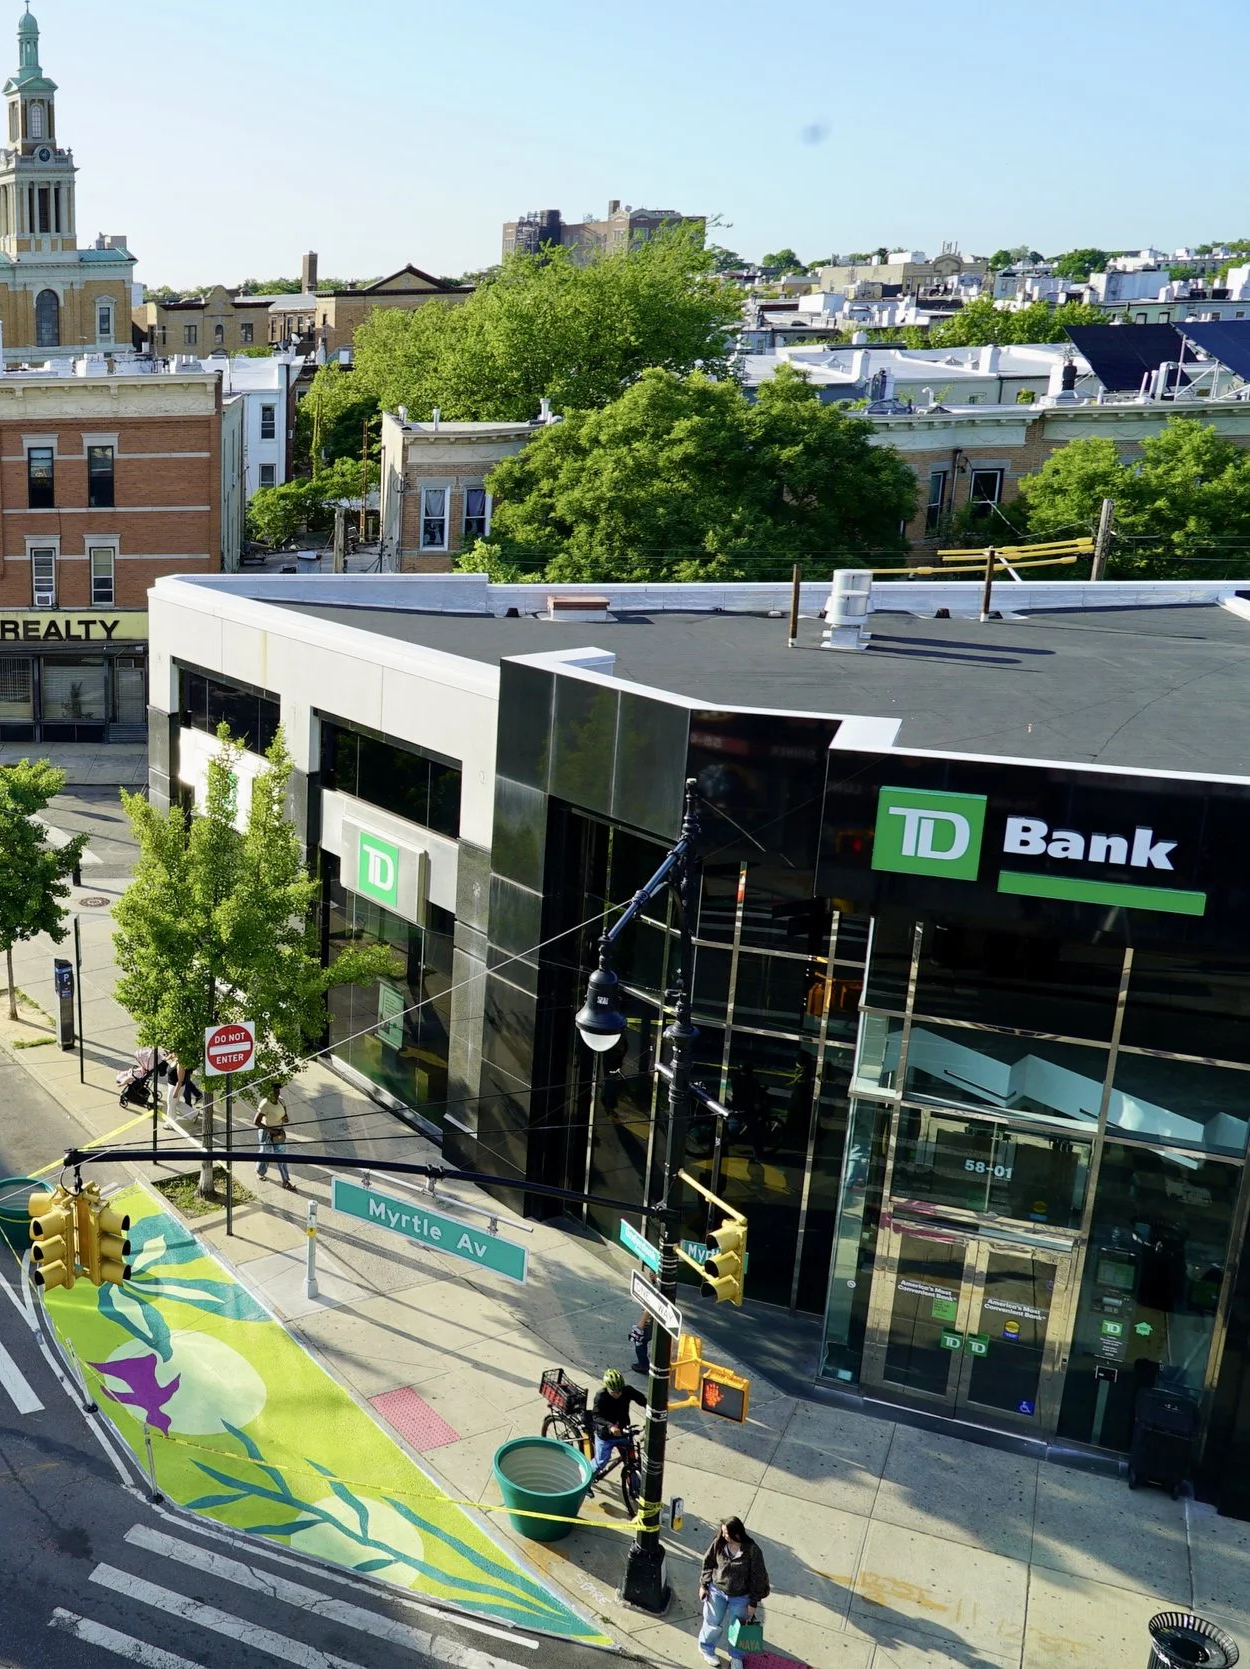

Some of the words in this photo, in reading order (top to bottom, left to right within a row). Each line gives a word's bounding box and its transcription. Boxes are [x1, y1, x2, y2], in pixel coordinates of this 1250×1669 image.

[0, 620, 120, 640] REALTY
[888, 806, 970, 861] TD
[1003, 814, 1178, 871] Bank
[362, 843, 395, 892] TD
[214, 1035, 227, 1044] DO
[228, 1032, 245, 1042] NOT
[216, 1053, 244, 1065] ENTER
[965, 1159, 1012, 1178] 58-01
[368, 1198, 442, 1241] Myrtle
[456, 1232, 488, 1258] Av
[688, 1243, 720, 1265] Myrt
[898, 1284, 935, 1298] Convenient
[900, 1280, 934, 1291] America's
[934, 1287, 952, 1296] Most
[634, 1281, 650, 1299] ONE
[658, 1304, 674, 1321] WAY
[987, 1298, 1022, 1311] America's
[1023, 1306, 1041, 1315] Most
[983, 1303, 1024, 1317] Convenient
[1104, 1322, 1121, 1334] TD
[943, 1335, 960, 1349] TD
[968, 1340, 986, 1354] TD
